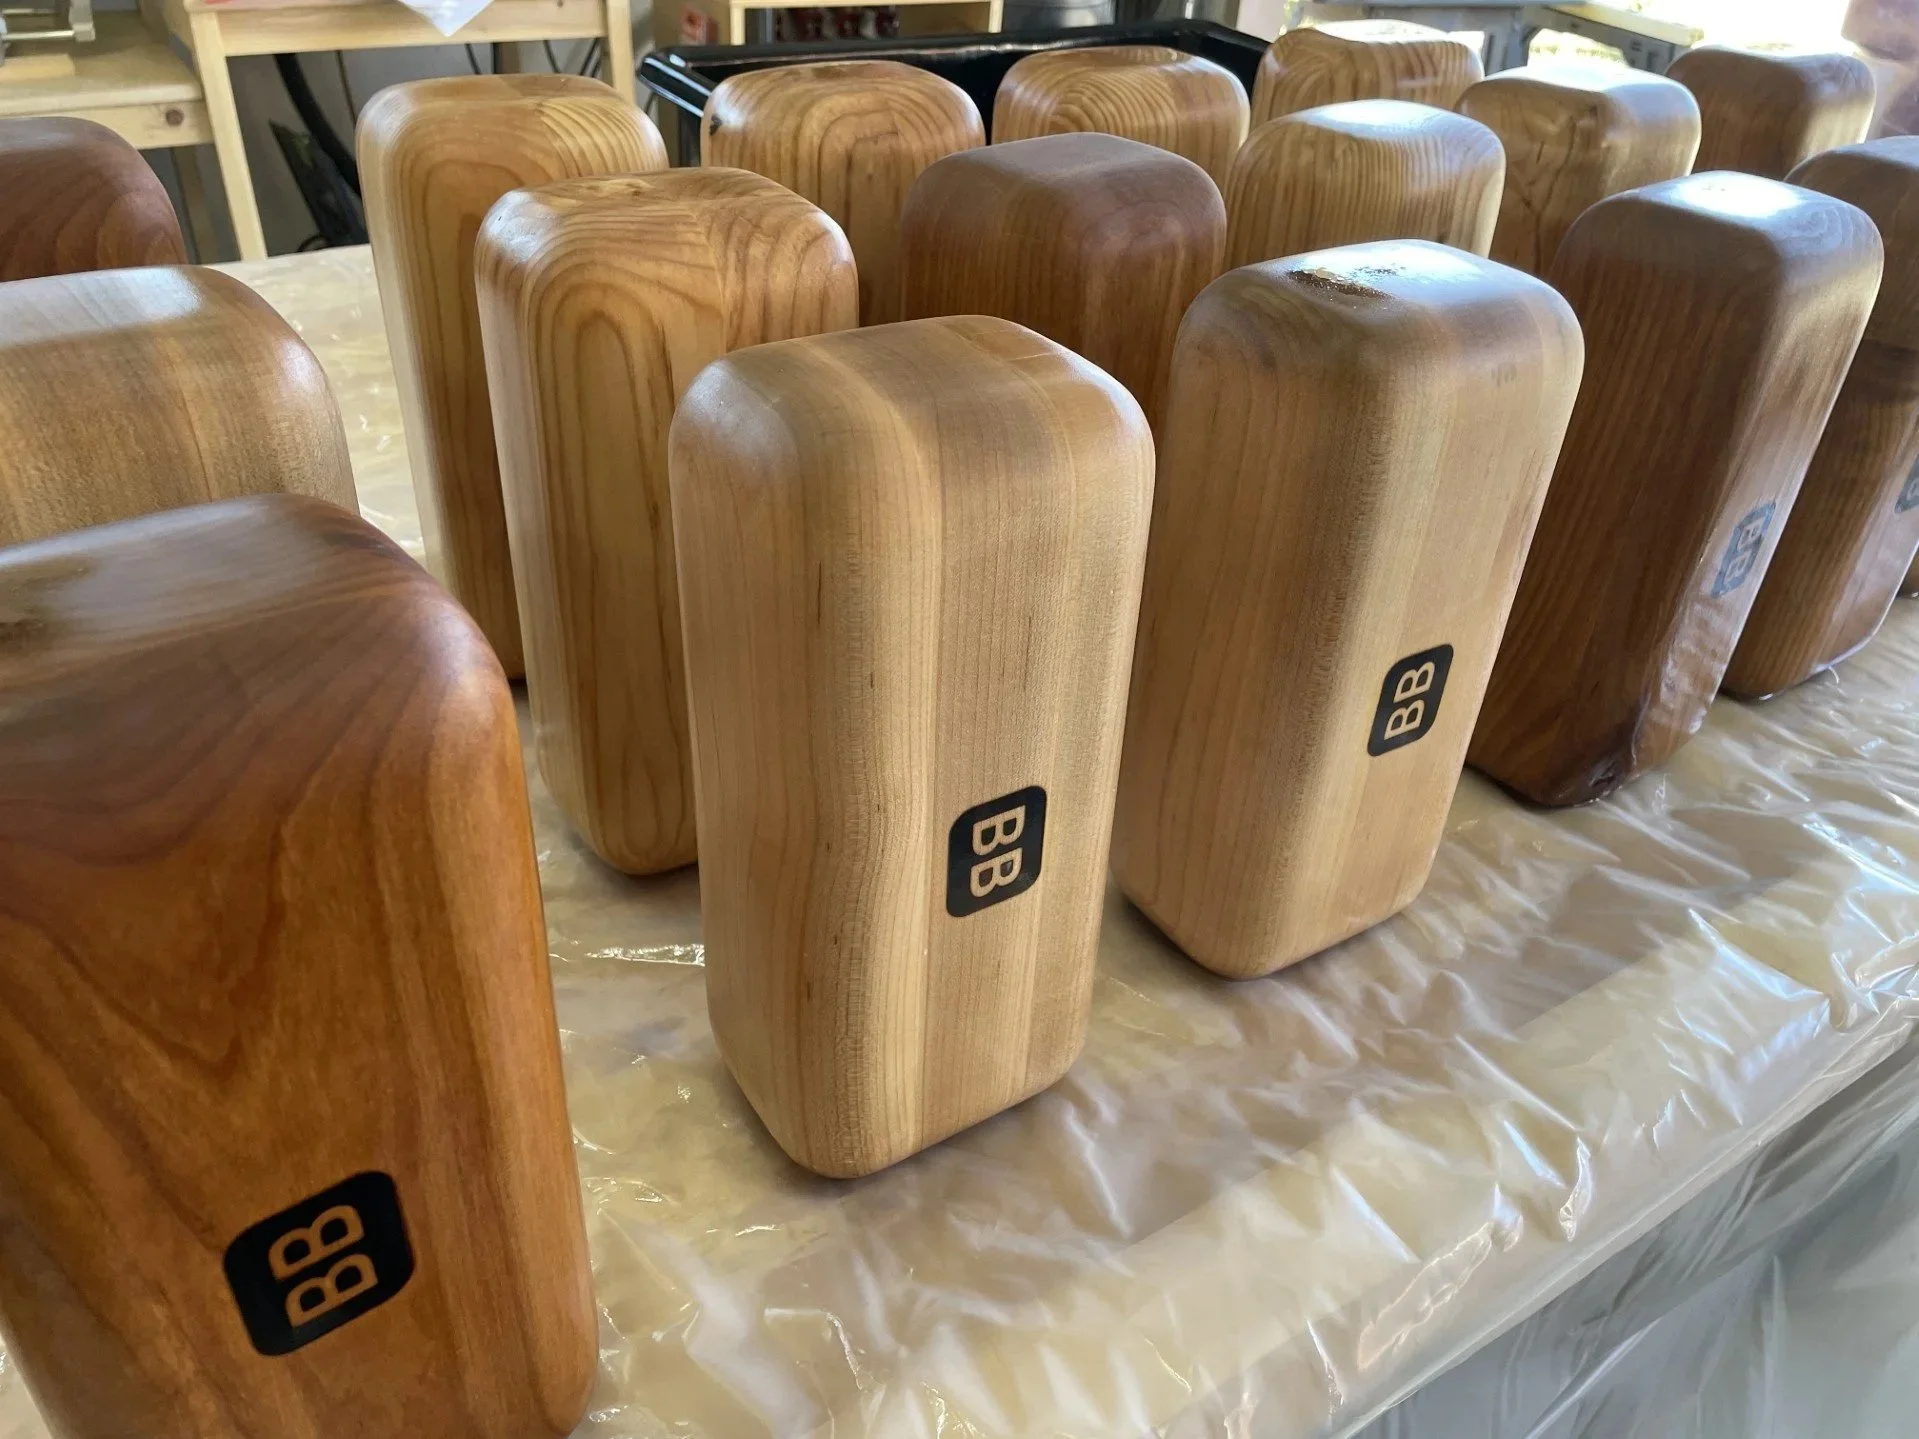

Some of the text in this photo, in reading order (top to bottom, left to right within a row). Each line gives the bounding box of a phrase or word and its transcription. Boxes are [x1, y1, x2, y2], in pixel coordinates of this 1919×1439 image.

[1383, 661, 1436, 741] BB
[970, 805, 1026, 897] BB
[268, 1204, 379, 1329] BB
